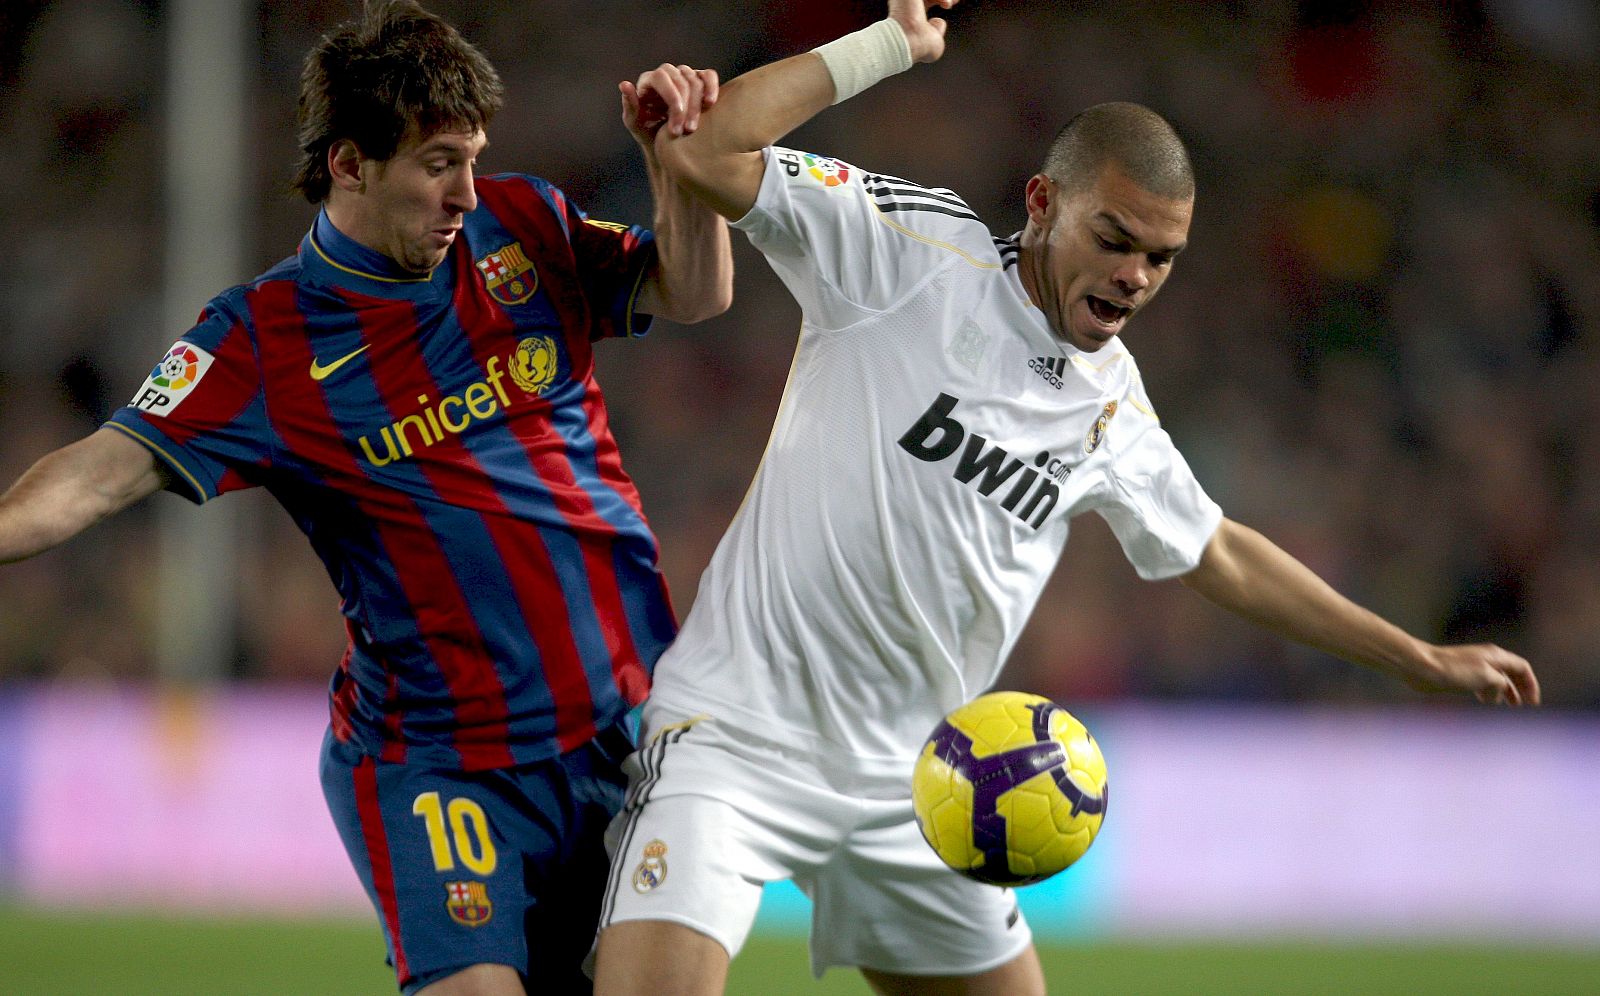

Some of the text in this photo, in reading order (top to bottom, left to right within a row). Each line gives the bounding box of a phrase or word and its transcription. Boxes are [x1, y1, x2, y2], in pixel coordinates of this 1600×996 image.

[774, 148, 800, 177] FP
[127, 387, 170, 410] FP
[1027, 359, 1064, 390] adidas
[358, 355, 512, 467] unicef
[897, 391, 1060, 530] bwin
[412, 790, 497, 876] 10
